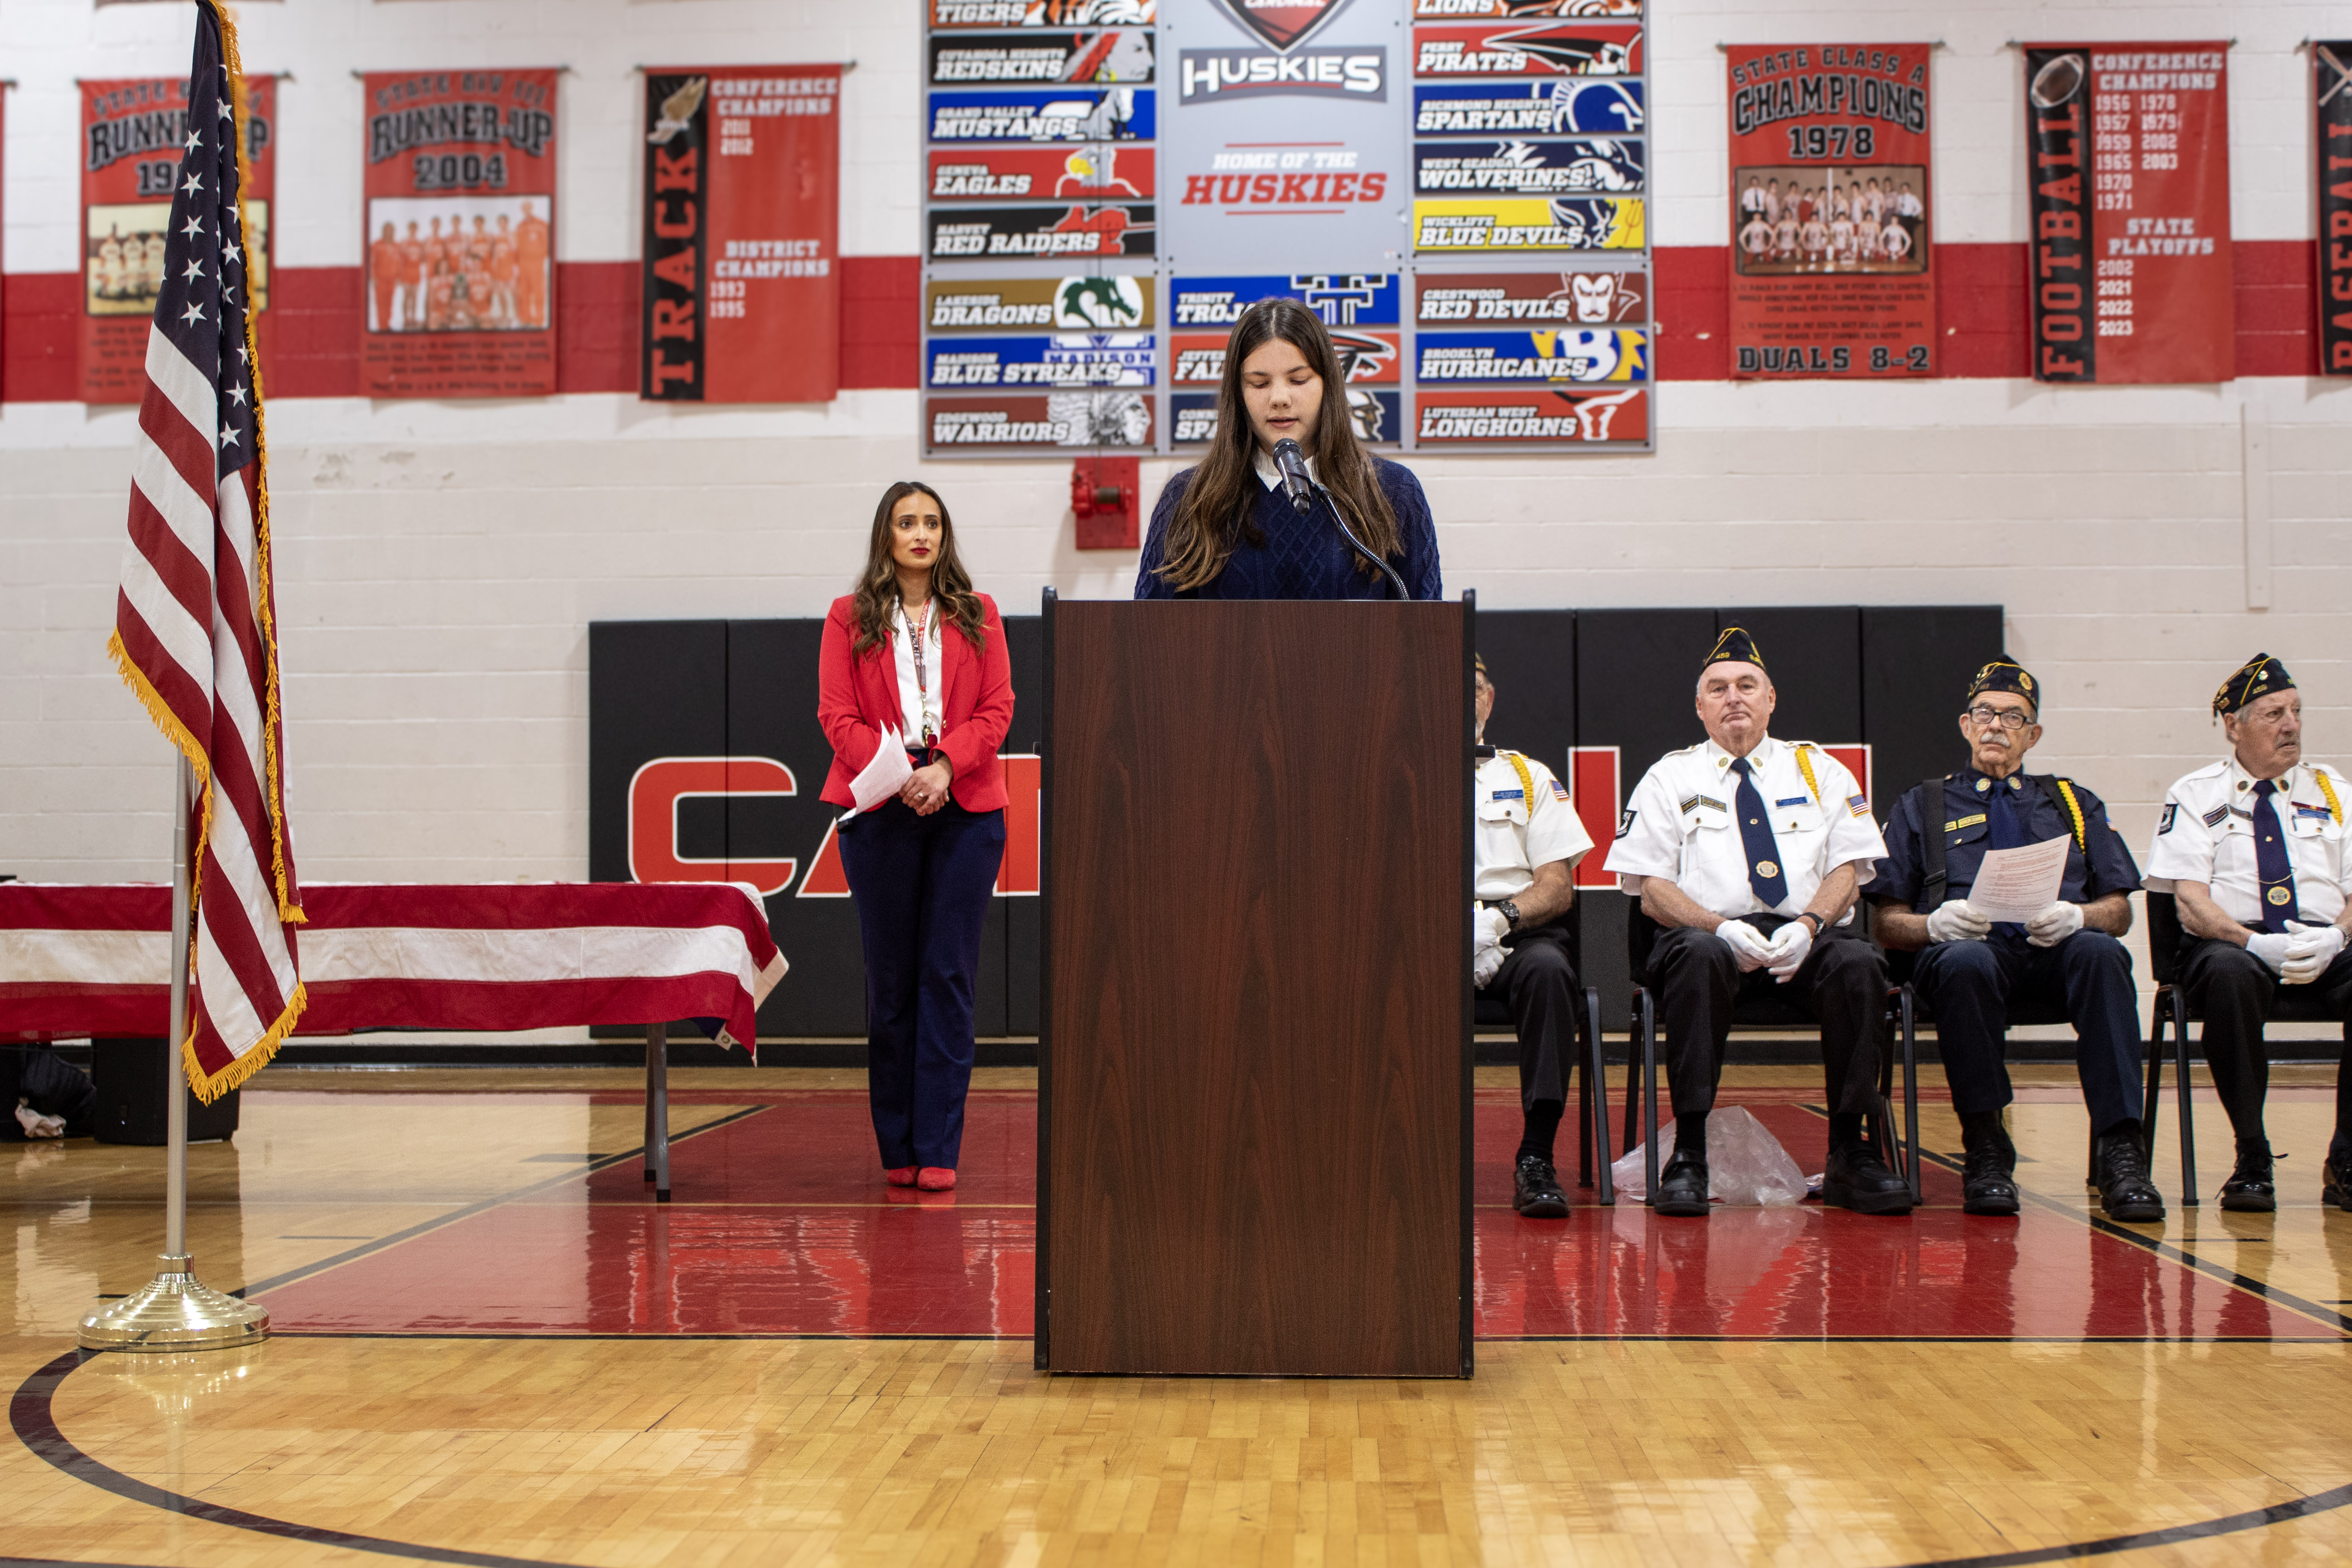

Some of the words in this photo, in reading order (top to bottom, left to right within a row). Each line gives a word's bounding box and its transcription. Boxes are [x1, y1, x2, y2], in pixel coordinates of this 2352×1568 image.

[936, 4, 1027, 22] TIGERS
[1416, 0, 1495, 14] LIONS
[1420, 42, 1466, 53] PERRY
[933, 60, 1064, 80] REDSKINS
[1416, 52, 1529, 72] PIRATES
[1733, 49, 1808, 86] STATE
[1822, 48, 1900, 73] CLASS
[1910, 64, 1926, 83] A
[2092, 54, 2224, 71] CONFERENCE
[1182, 56, 1381, 97] HUSKIES
[2099, 73, 2218, 91] CHAMPIONS
[376, 74, 451, 109] STATE
[710, 78, 838, 97] CONFERENCE
[93, 80, 166, 117] STATE
[717, 98, 833, 116] CHAMPIONS
[1420, 99, 1492, 111] RICHMOND
[1494, 98, 1553, 110] HEIGHTS
[1732, 73, 1927, 136] CHAMPIONS
[2095, 94, 2131, 112] 1956
[2140, 94, 2176, 111] 1978
[936, 107, 982, 118] GRAND
[983, 106, 1036, 117] VALLEY
[1416, 110, 1553, 130] SPARTANS
[720, 119, 751, 137] 2011
[932, 117, 1078, 138] MUSTANGS
[2095, 114, 2131, 131] 1957
[2141, 113, 2176, 131] 1979
[369, 102, 553, 164] RUNNER-UP
[2141, 133, 2177, 151] 2002
[1788, 125, 1875, 160] 1978
[1212, 152, 1278, 170] HOME
[1280, 152, 1310, 169] OF
[1313, 151, 1358, 168] THE
[1421, 158, 1460, 170] WEST
[1461, 157, 1515, 169] GEAUGA
[2096, 154, 2132, 171] 1965
[2141, 153, 2178, 170] 2003
[413, 152, 507, 190] 2004
[936, 165, 989, 176] GENEVA
[1418, 168, 1588, 188] WOLVERINES
[933, 175, 1032, 195] EAGLES
[1181, 172, 1387, 205] HUSKIES
[2097, 174, 2132, 191] 1970
[2097, 194, 2132, 210] 1971
[936, 224, 991, 235] HARVEY
[1422, 216, 1496, 227] WICKLIFFE
[2127, 218, 2195, 235] STATE
[933, 235, 986, 254] RED
[988, 232, 1101, 254] RAIDERS
[1418, 227, 1488, 246] BLUE
[1489, 225, 1585, 245] DEVILS
[2038, 103, 2084, 376] FOOTBALL
[725, 240, 820, 258] DISTRICT
[2107, 238, 2215, 255] PLAYOFFS
[651, 147, 697, 395] TRACK
[715, 259, 831, 278] CHAMPIONS
[2097, 259, 2133, 275] 2002
[1423, 289, 1505, 300] CRESTWOOD
[2097, 279, 2132, 296] 2021
[935, 295, 1000, 306] LAKESIDE
[1178, 292, 1235, 303] TRINITY
[931, 305, 1053, 326] DRAGONS
[1419, 300, 1473, 320] RED
[1475, 299, 1571, 319] DEVILS
[2098, 300, 2133, 316] 2022
[2098, 320, 2133, 337] 2023
[1050, 353, 1151, 364] MADISON
[1423, 348, 1496, 359] BROOKLYN
[1737, 346, 1851, 372] DUALS
[1869, 346, 1930, 371] 8-2
[931, 363, 1001, 385] BLUE
[1003, 362, 1123, 383] STREAKS
[1419, 357, 1588, 379] HURRICANES
[935, 412, 1008, 424] EDGEWOOD
[1423, 407, 1496, 418] LUTHERAN
[1498, 407, 1539, 417] WEST
[933, 422, 1070, 443] WARRIORS
[1419, 417, 1578, 438] LONGHORNS
